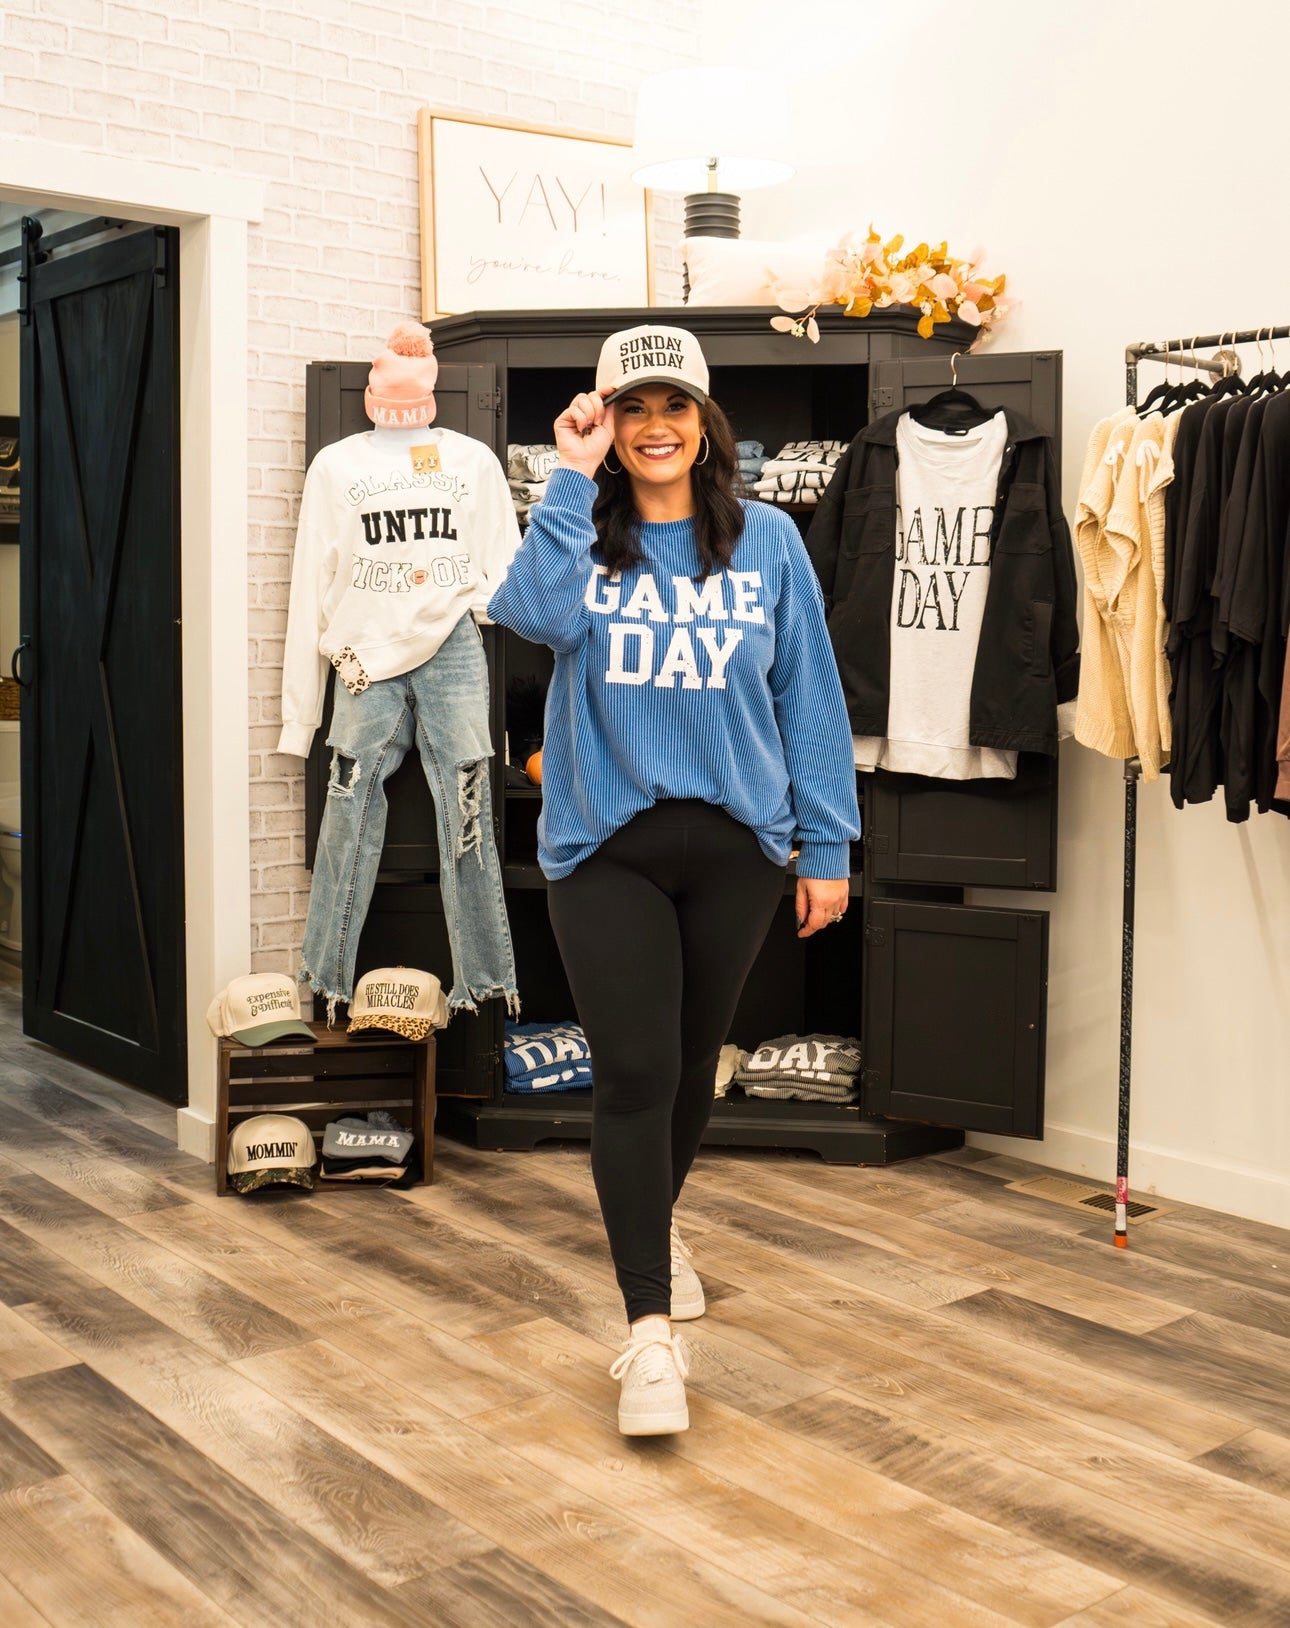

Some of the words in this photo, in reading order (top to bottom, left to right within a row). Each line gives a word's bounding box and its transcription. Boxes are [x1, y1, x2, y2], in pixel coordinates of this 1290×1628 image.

[479, 165, 607, 238] YAY!
[466, 256, 551, 285] you're
[619, 335, 682, 357] SUNDAY
[620, 351, 685, 375] FUNDAY
[372, 404, 429, 426] MAMA
[361, 507, 457, 546] UNTIL
[584, 563, 766, 625] GAME
[896, 568, 971, 632] DAY
[605, 622, 744, 690] DAY
[246, 988, 291, 1004] Expensive
[367, 994, 416, 1010] MIRACLES
[375, 982, 397, 994] STILL
[399, 983, 420, 998] DOES
[748, 1041, 842, 1070] DAY
[335, 1131, 400, 1148] MAMA
[246, 1142, 298, 1162] MOMMIN'
